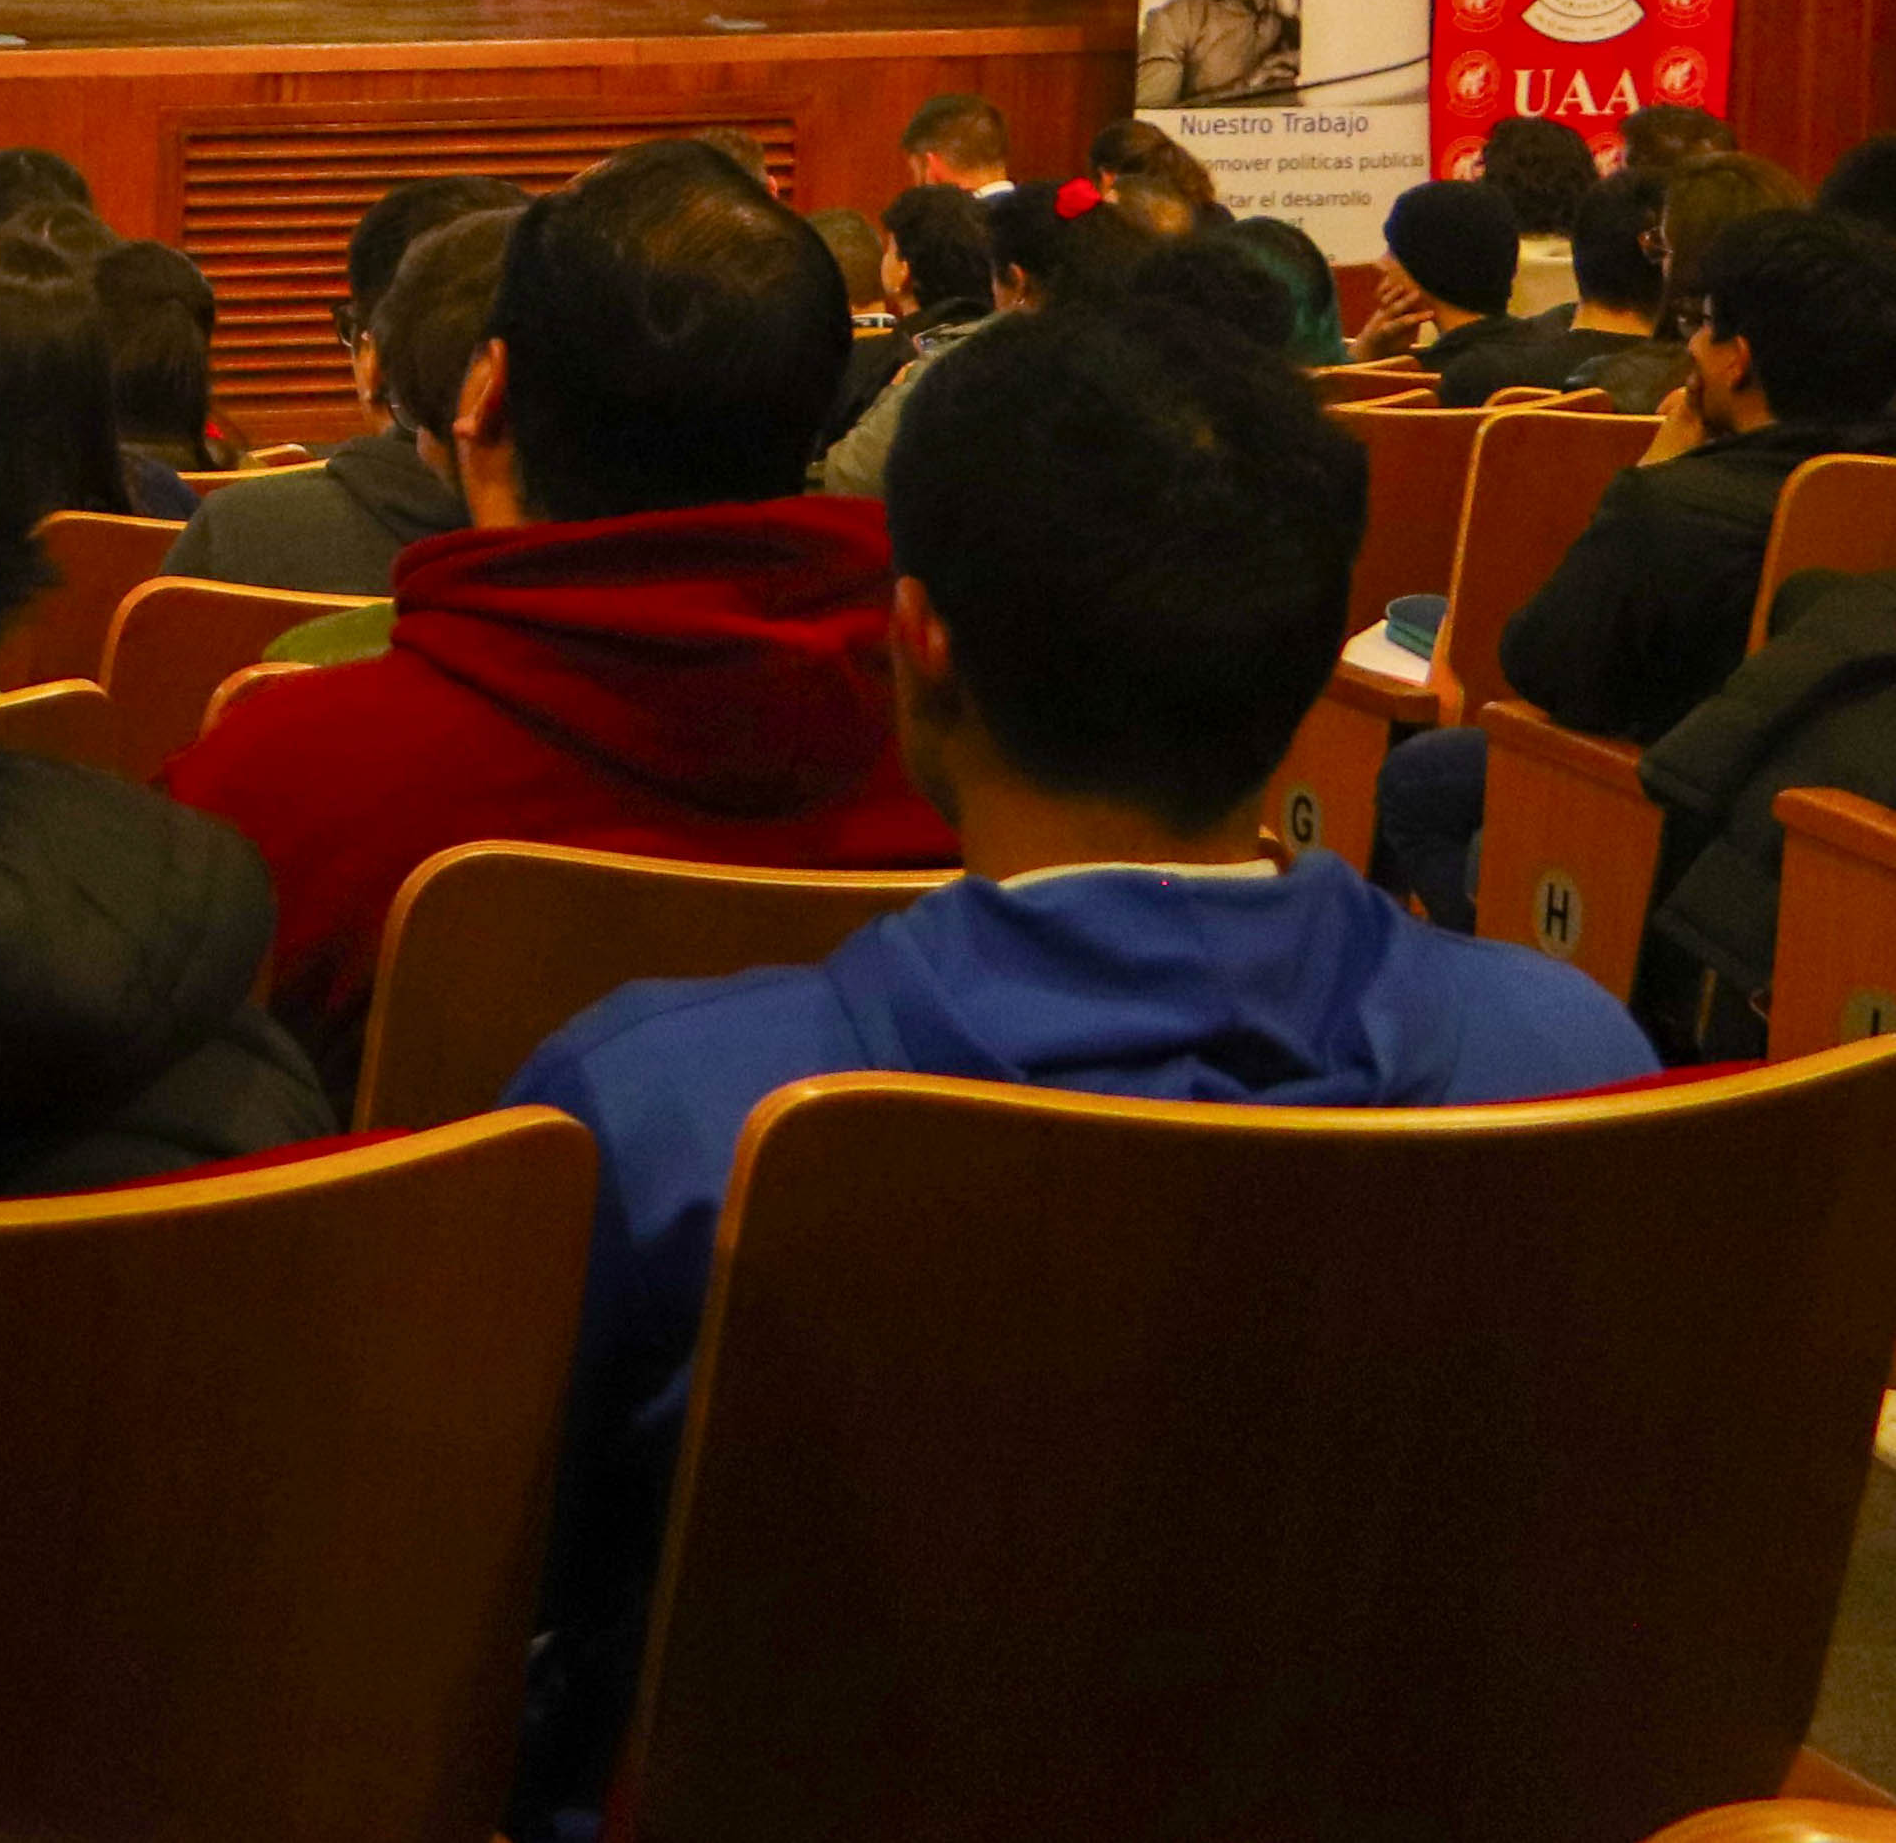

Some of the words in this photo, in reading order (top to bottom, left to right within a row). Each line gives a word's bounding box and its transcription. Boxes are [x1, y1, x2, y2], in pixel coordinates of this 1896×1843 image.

[1513, 68, 1642, 118] UAA
[1180, 113, 1274, 137] Nuestro
[1281, 111, 1370, 139] Trabajo
[1259, 190, 1276, 208] el
[1281, 189, 1373, 208] desarrollo
[1291, 794, 1314, 843] G
[1545, 882, 1570, 943] H
